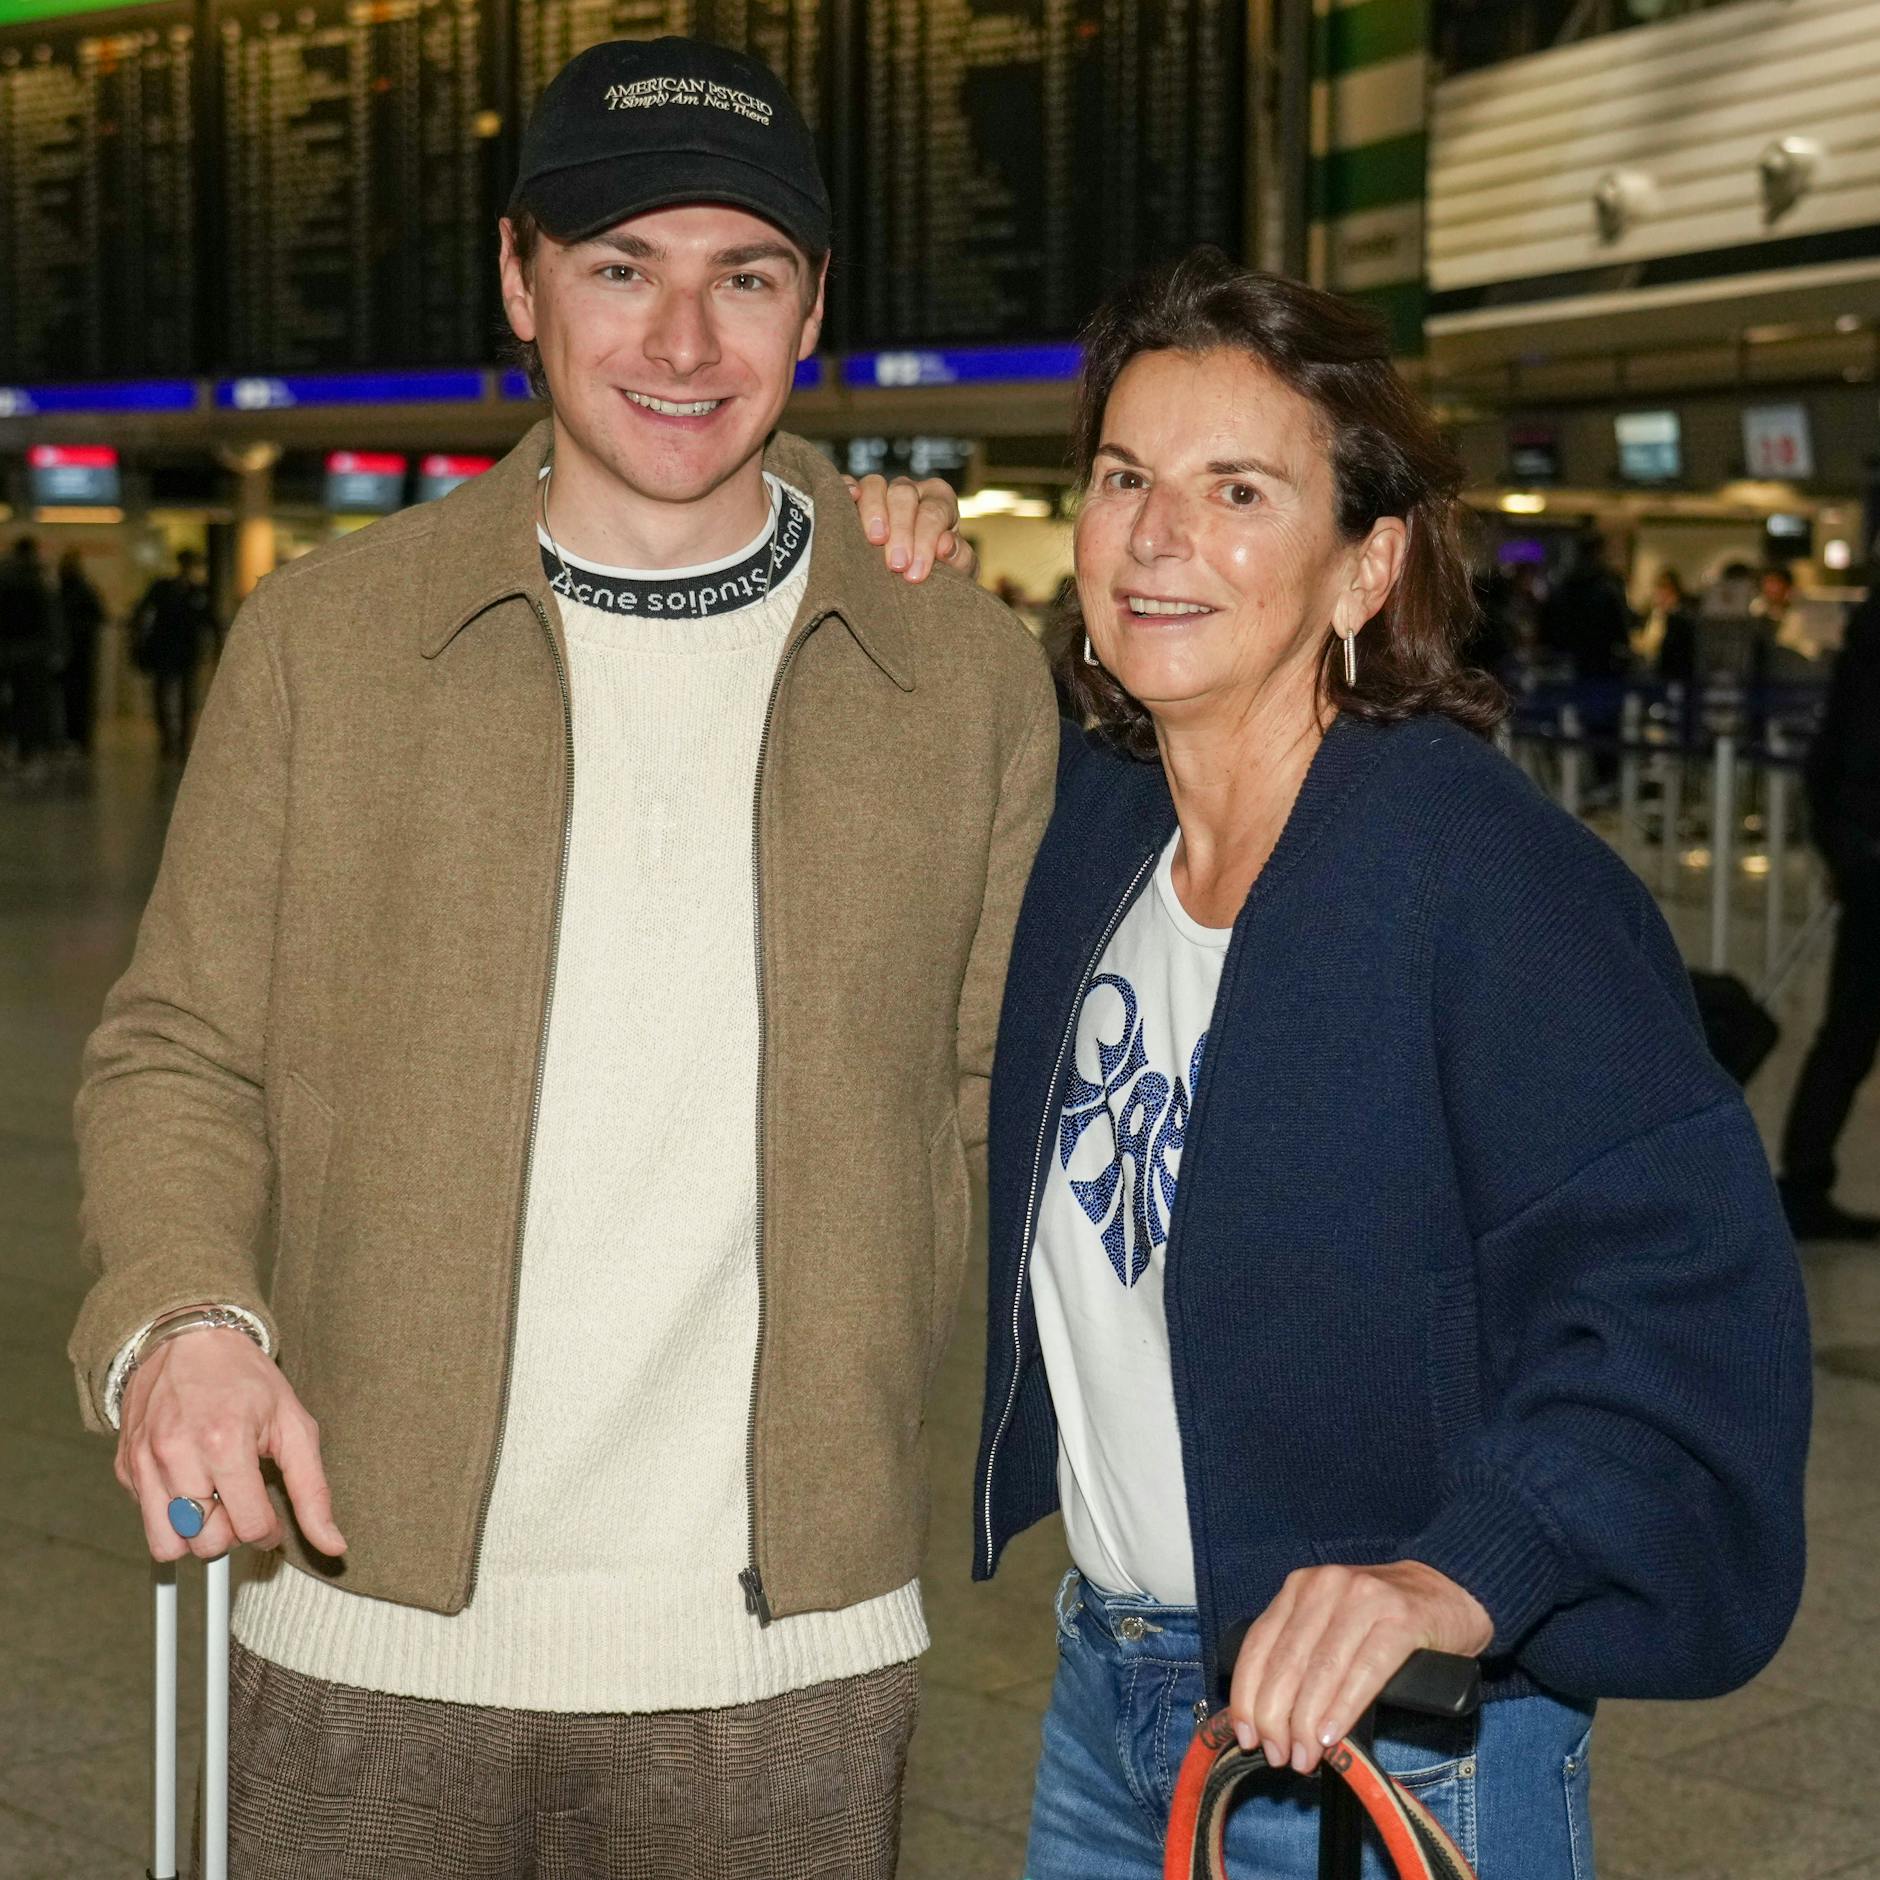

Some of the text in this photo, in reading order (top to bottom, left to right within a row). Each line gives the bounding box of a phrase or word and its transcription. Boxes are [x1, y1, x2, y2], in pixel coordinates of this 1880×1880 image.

[604, 77, 774, 117] AMERICAN PSYCHO
[608, 91, 770, 126] I Simply Am Not There
[550, 567, 638, 609] Acne
[768, 507, 803, 569] Acne
